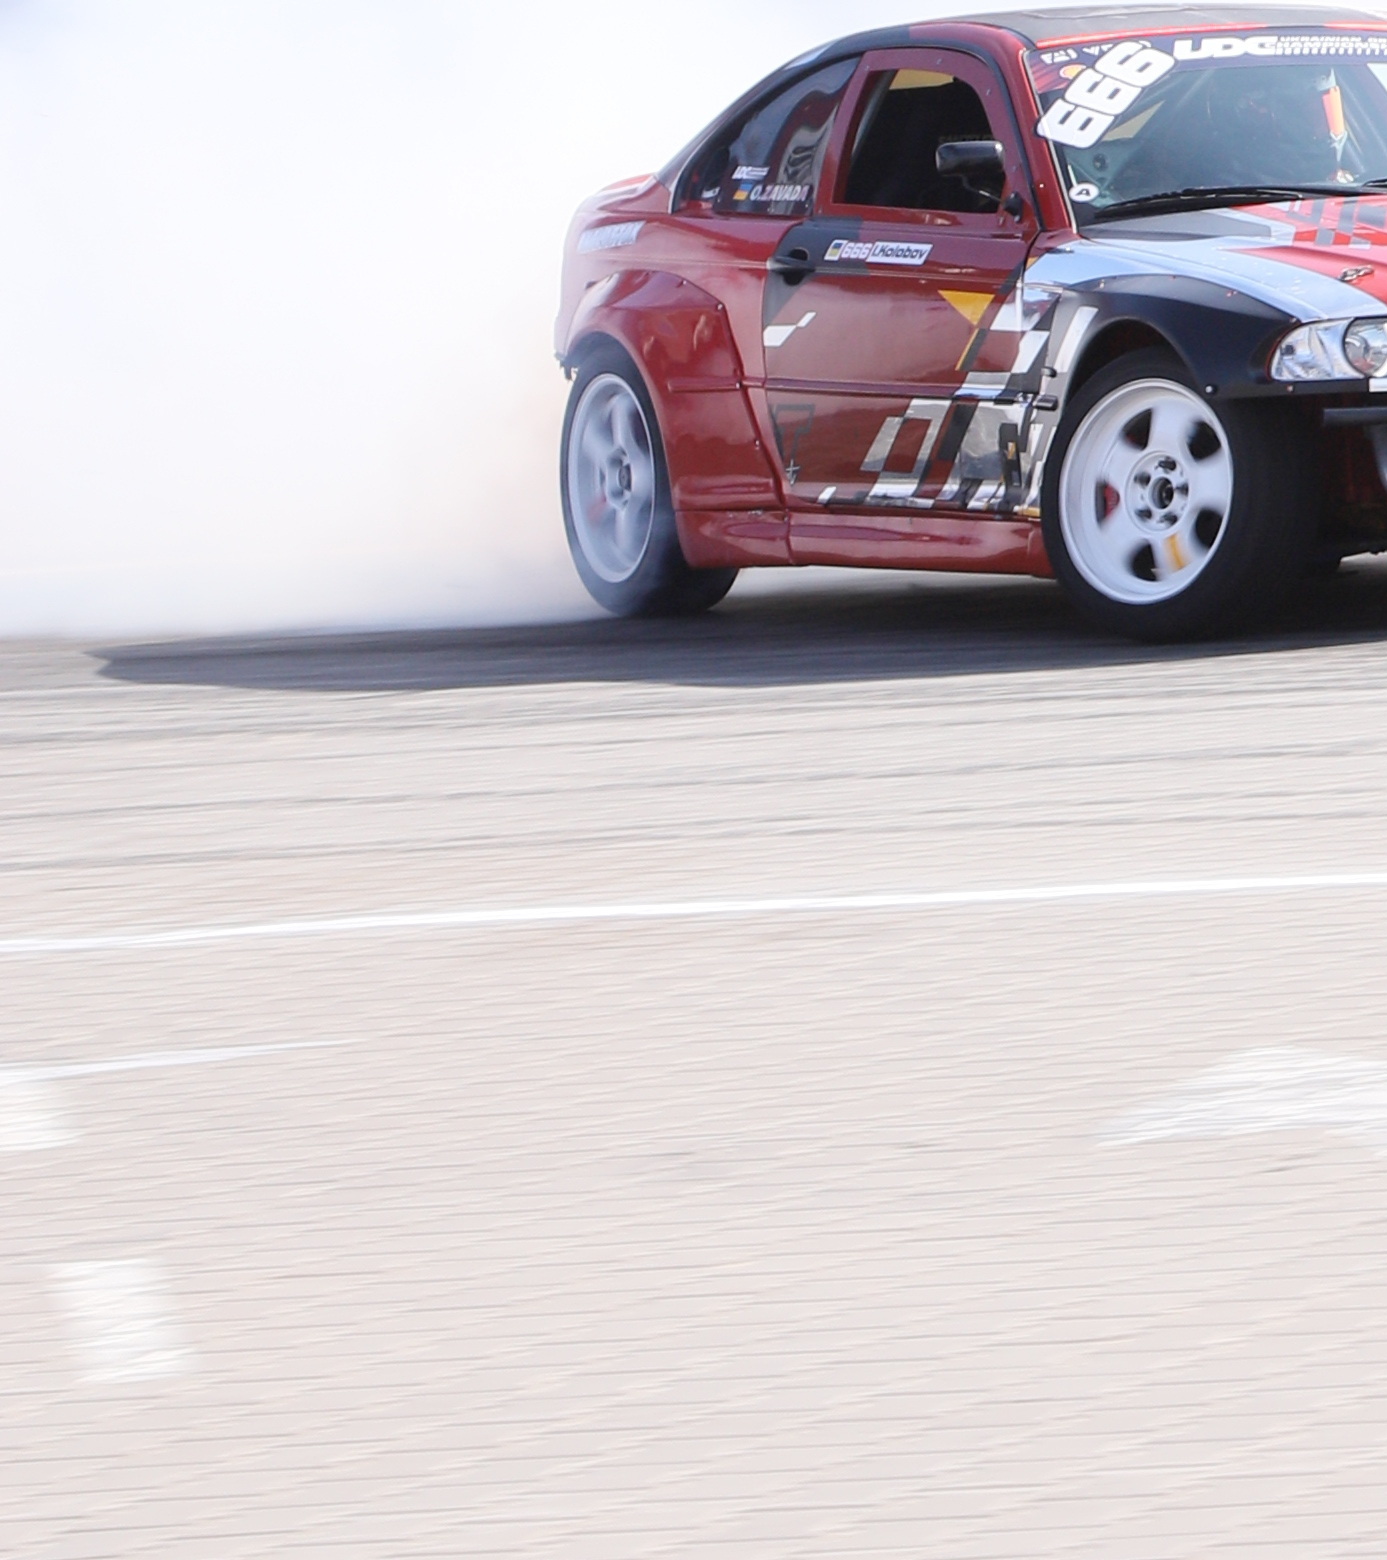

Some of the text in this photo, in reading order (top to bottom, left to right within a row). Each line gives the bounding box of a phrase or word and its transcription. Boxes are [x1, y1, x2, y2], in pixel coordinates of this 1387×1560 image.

[1173, 36, 1278, 60] UDC
[1037, 40, 1176, 149] 666
[841, 242, 873, 259] 666
